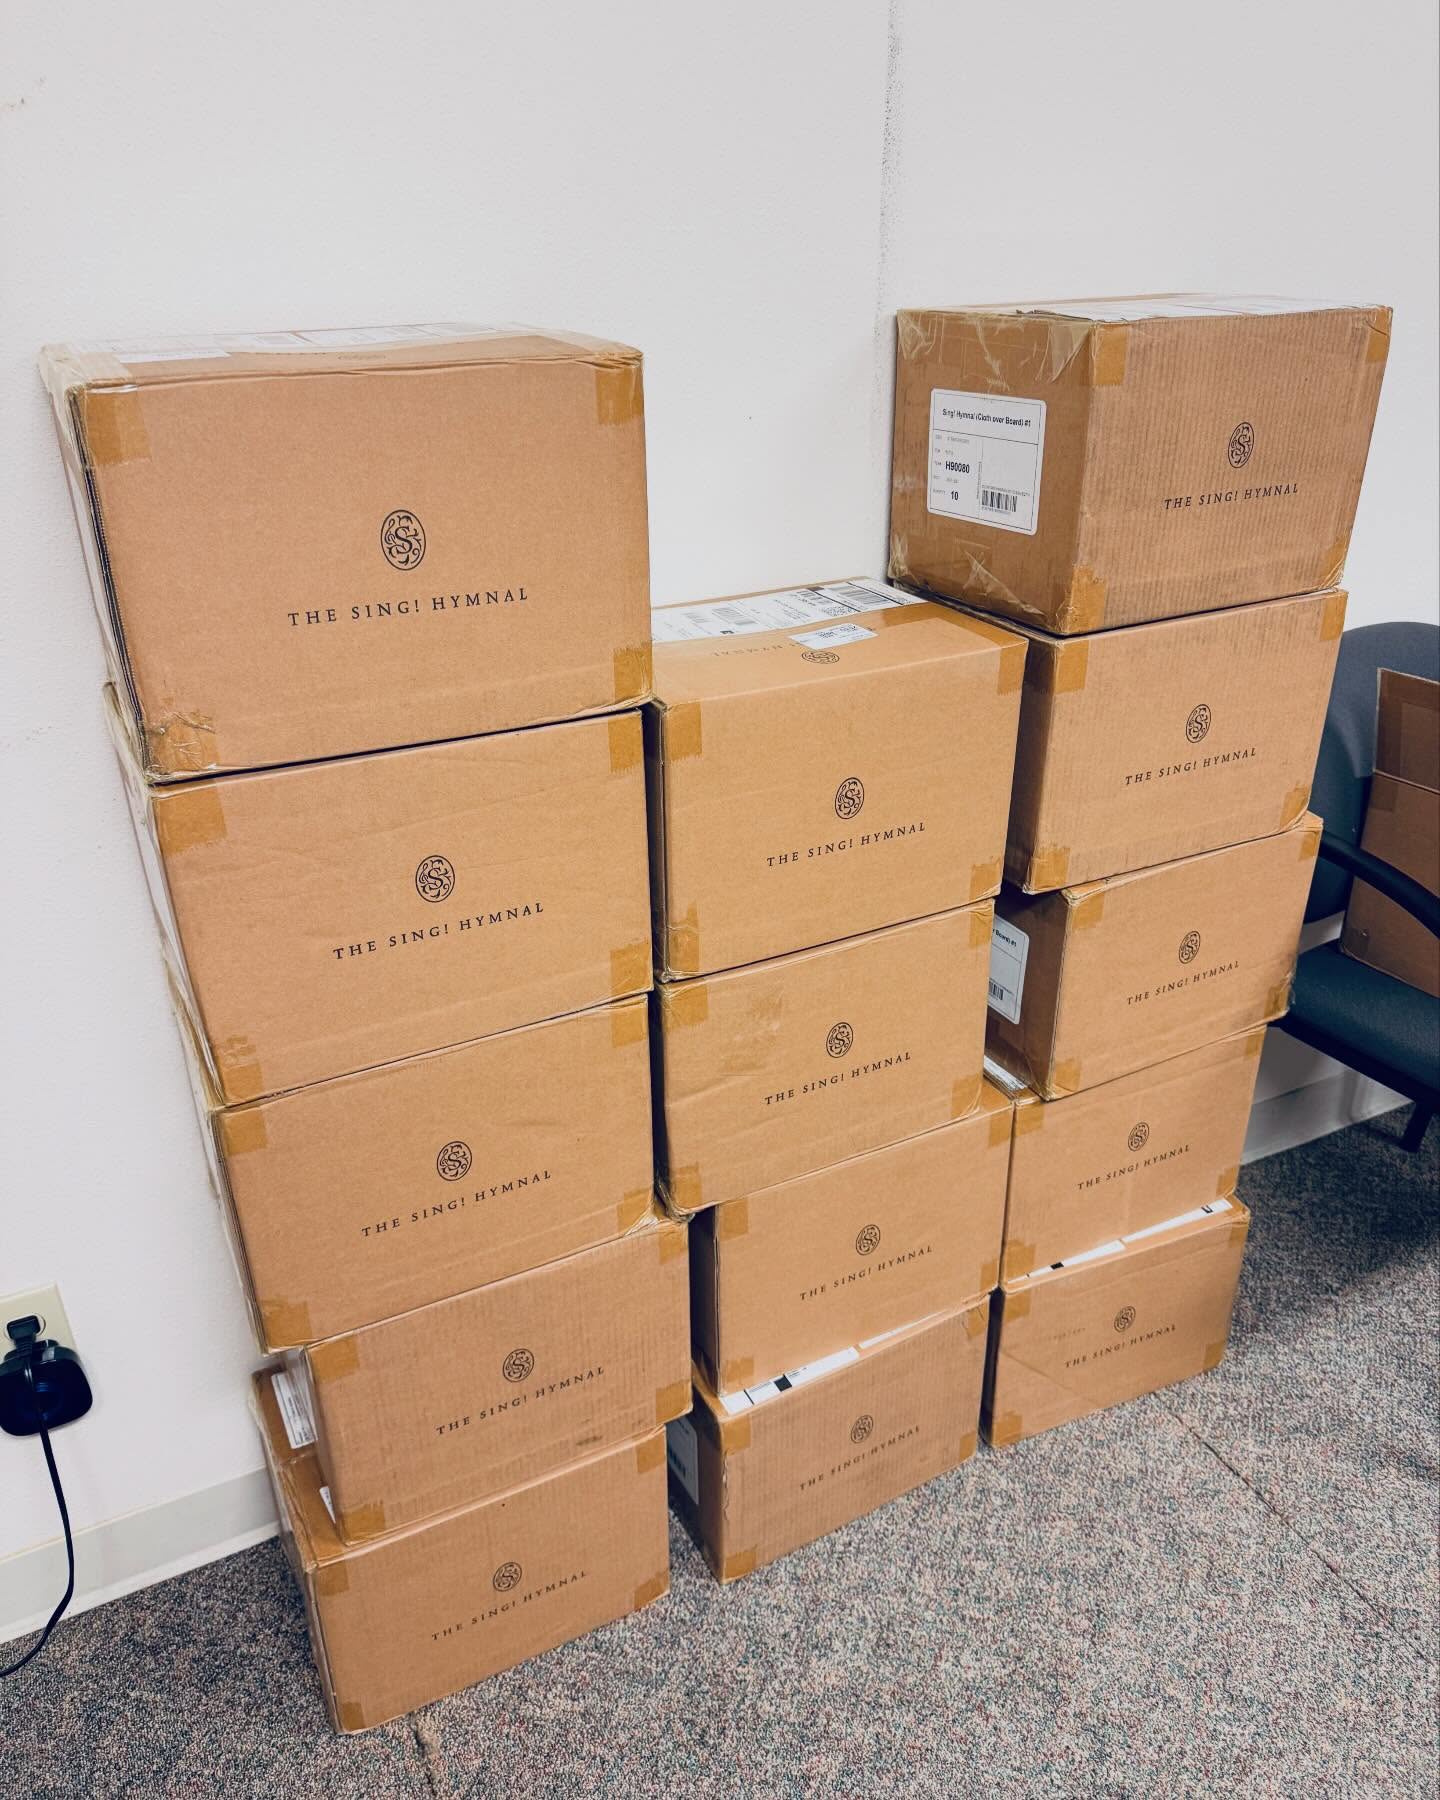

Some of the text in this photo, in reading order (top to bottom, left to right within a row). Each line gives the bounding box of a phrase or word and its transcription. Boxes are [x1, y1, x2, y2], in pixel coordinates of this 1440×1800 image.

[992, 416, 1004, 424] over
[1005, 416, 1024, 427] Board)
[951, 490, 959, 501] 10
[1164, 483, 1298, 510] THE SING! HYMNAL
[288, 588, 527, 626] THE SING! HYMNAL
[1126, 748, 1256, 786] THE SING! HYMNAL
[767, 822, 925, 866] THE SING! HYMNAL
[333, 903, 543, 959] THE SING! HYMNAL
[1127, 961, 1239, 1005] THE SING! HYMNAL
[765, 1052, 911, 1105] THE SING! HYMNAL
[1078, 1145, 1189, 1190] THE SING! HYMNAL
[361, 1170, 551, 1237] THE SING! HYMNAL
[800, 1246, 932, 1300] THE SING! HYMNAL
[436, 1366, 604, 1435] THE SING! HYMNAL
[431, 1571, 586, 1640] THE SING! HYMNAL
